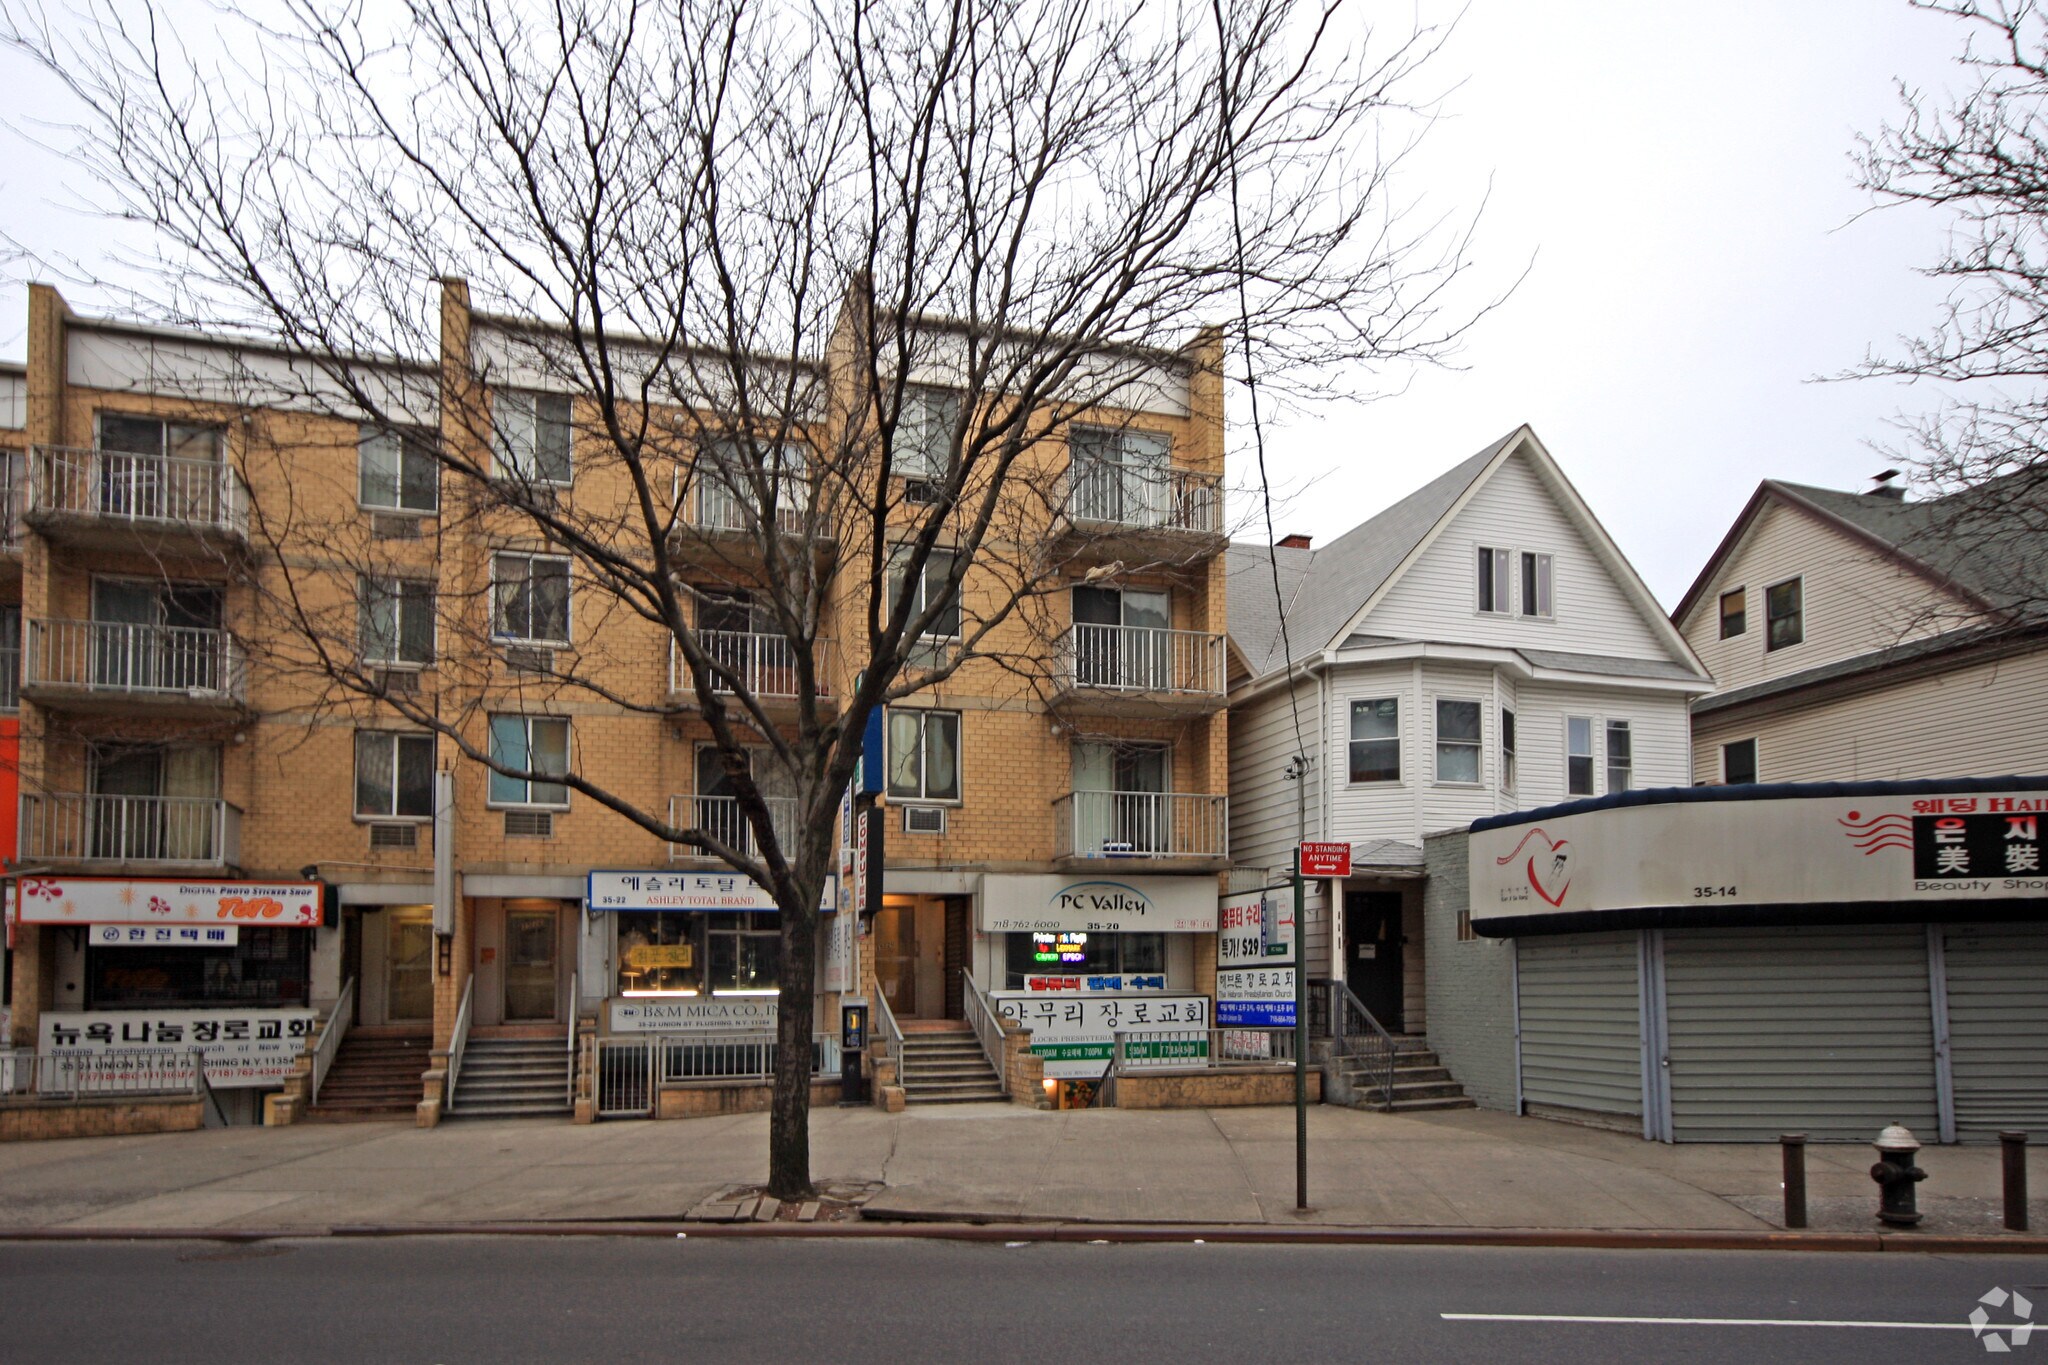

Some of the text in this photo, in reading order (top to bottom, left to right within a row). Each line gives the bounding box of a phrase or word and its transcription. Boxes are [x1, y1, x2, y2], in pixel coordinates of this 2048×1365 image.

[1912, 797, 2048, 814] 웨딩 HAI
[859, 815, 867, 908] COMPUTER
[1694, 886, 1737, 897] 35-14
[1915, 880, 1992, 891] Beauty
[646, 896, 755, 905] ASHLEY TOTAL BRAND
[1060, 893, 1146, 916] PC Valley
[1222, 907, 1243, 929] 컴퓨터
[1246, 903, 1260, 926] 수리
[1087, 922, 1120, 930] 35-20
[1222, 937, 1259, 958] 특가! $29
[1029, 976, 1081, 990] 컴퓨터
[643, 1005, 681, 1017] B&M
[687, 1005, 729, 1017] MICA
[1099, 1001, 1205, 1029] 장로교회
[1061, 1034, 1114, 1042] PRESBYTERIA
[51, 1047, 93, 1057] Sharing
[105, 1046, 174, 1056] Presbyterian
[188, 1044, 225, 1054] Church
[238, 1044, 249, 1052] of
[259, 1043, 280, 1051] New
[265, 1057, 295, 1066] 11354
